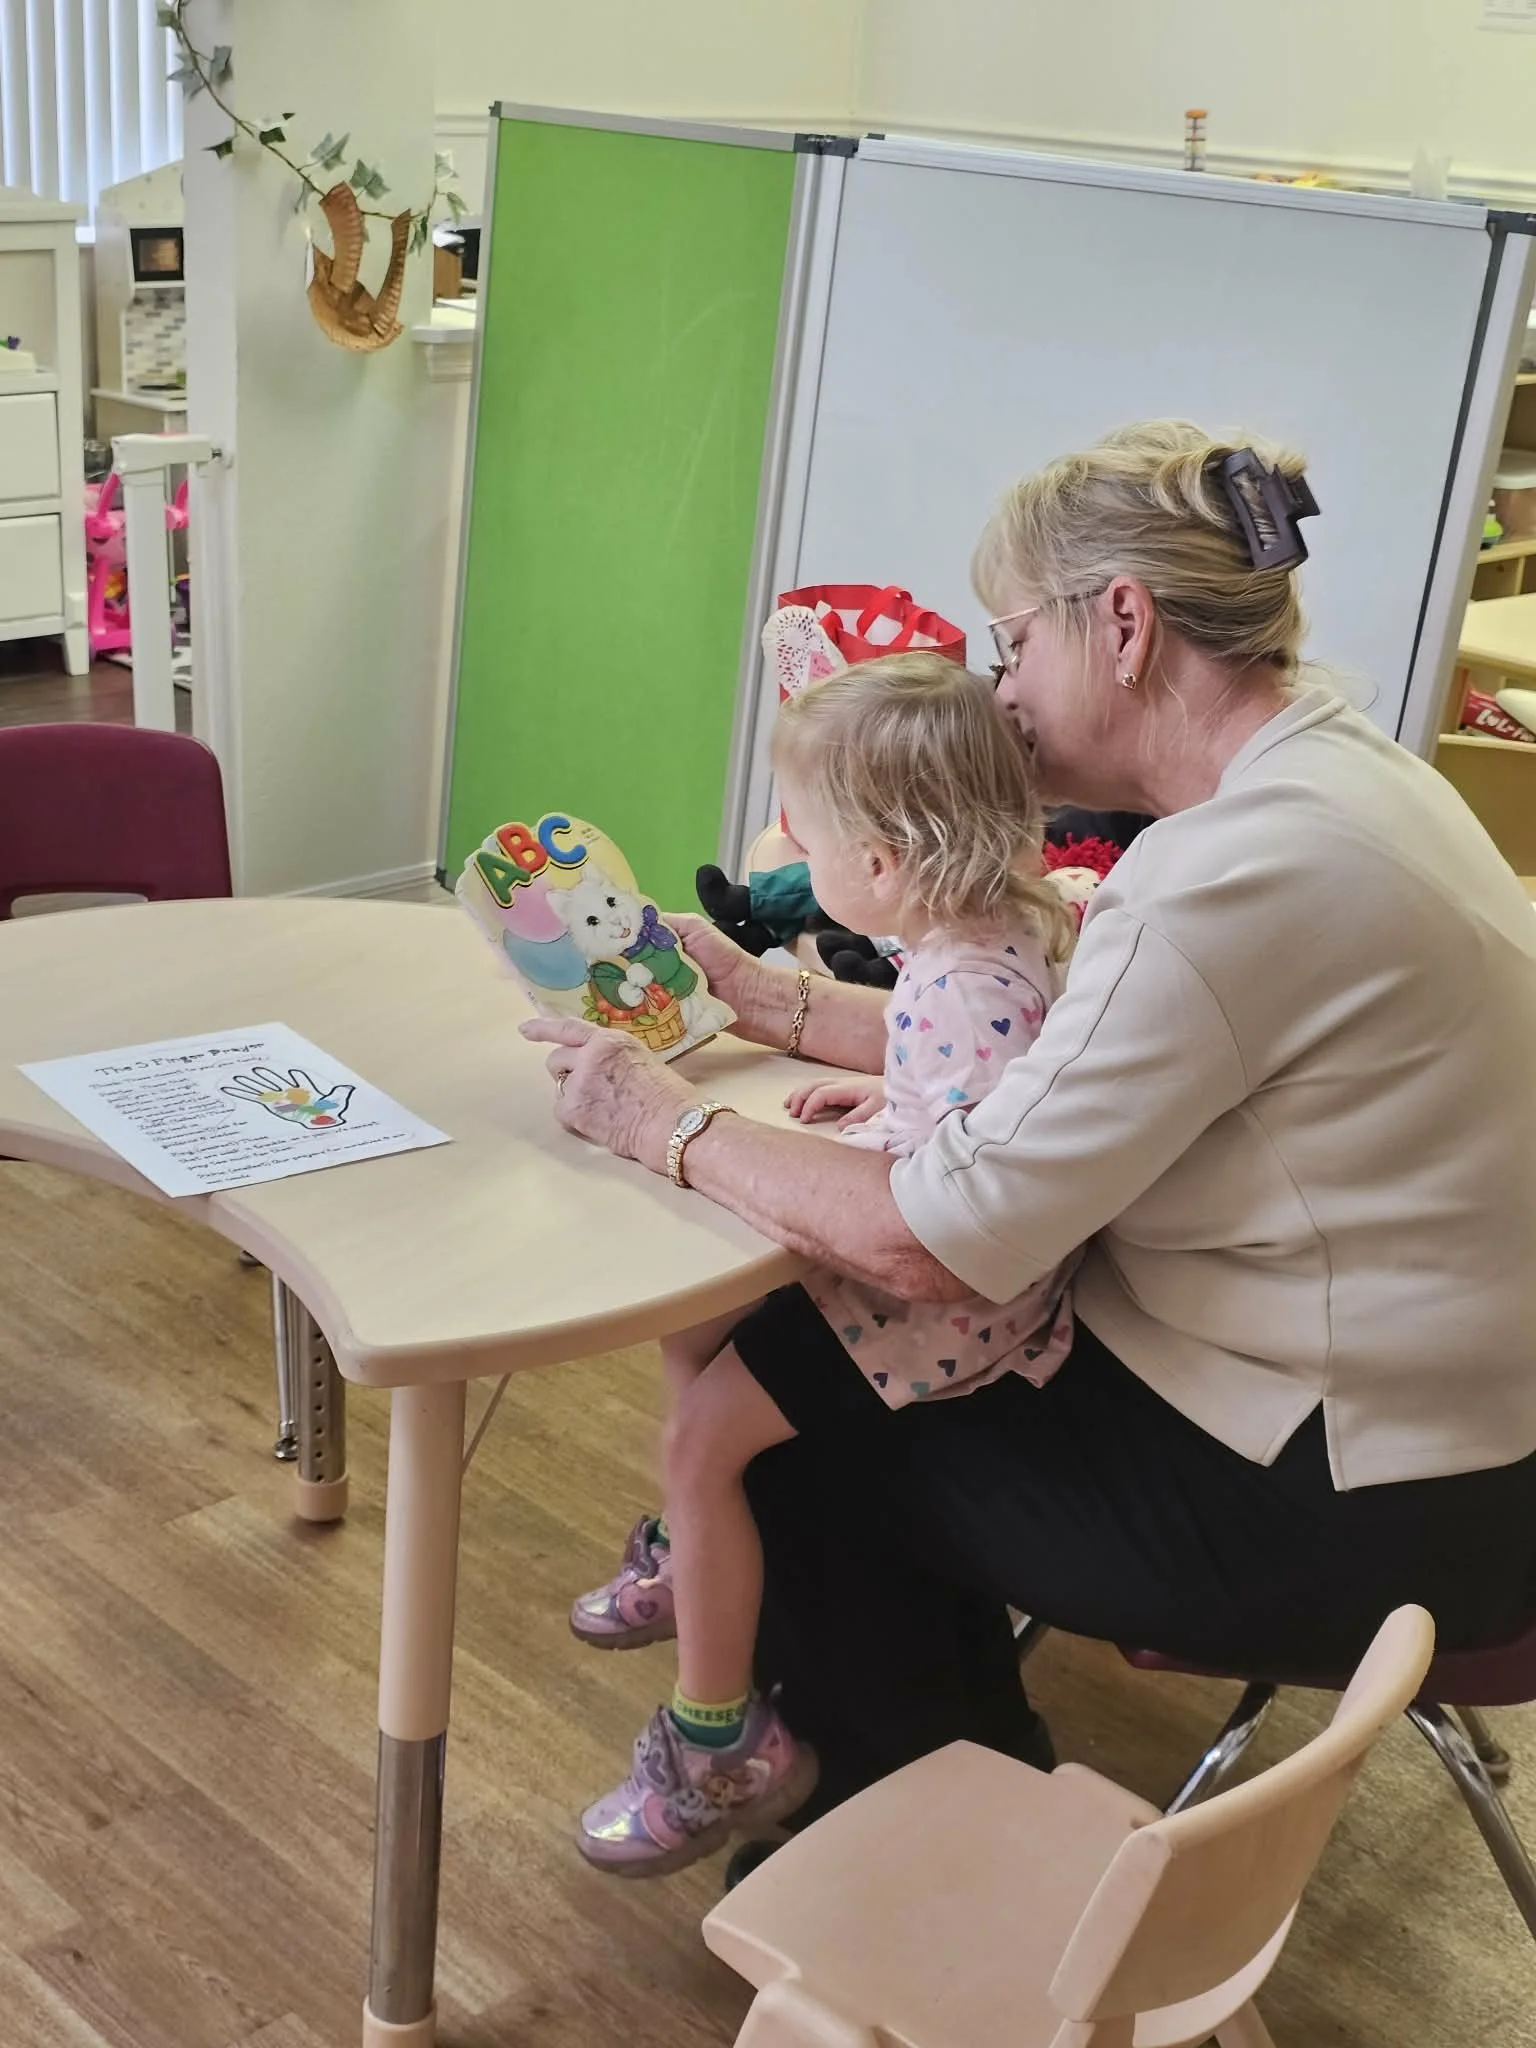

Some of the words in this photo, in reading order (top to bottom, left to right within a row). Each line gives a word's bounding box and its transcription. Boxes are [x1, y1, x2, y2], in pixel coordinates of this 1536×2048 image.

[475, 813, 588, 907] ABC
[95, 1066, 131, 1075] The
[151, 1054, 203, 1065] Finger
[208, 1043, 263, 1055] Prayer
